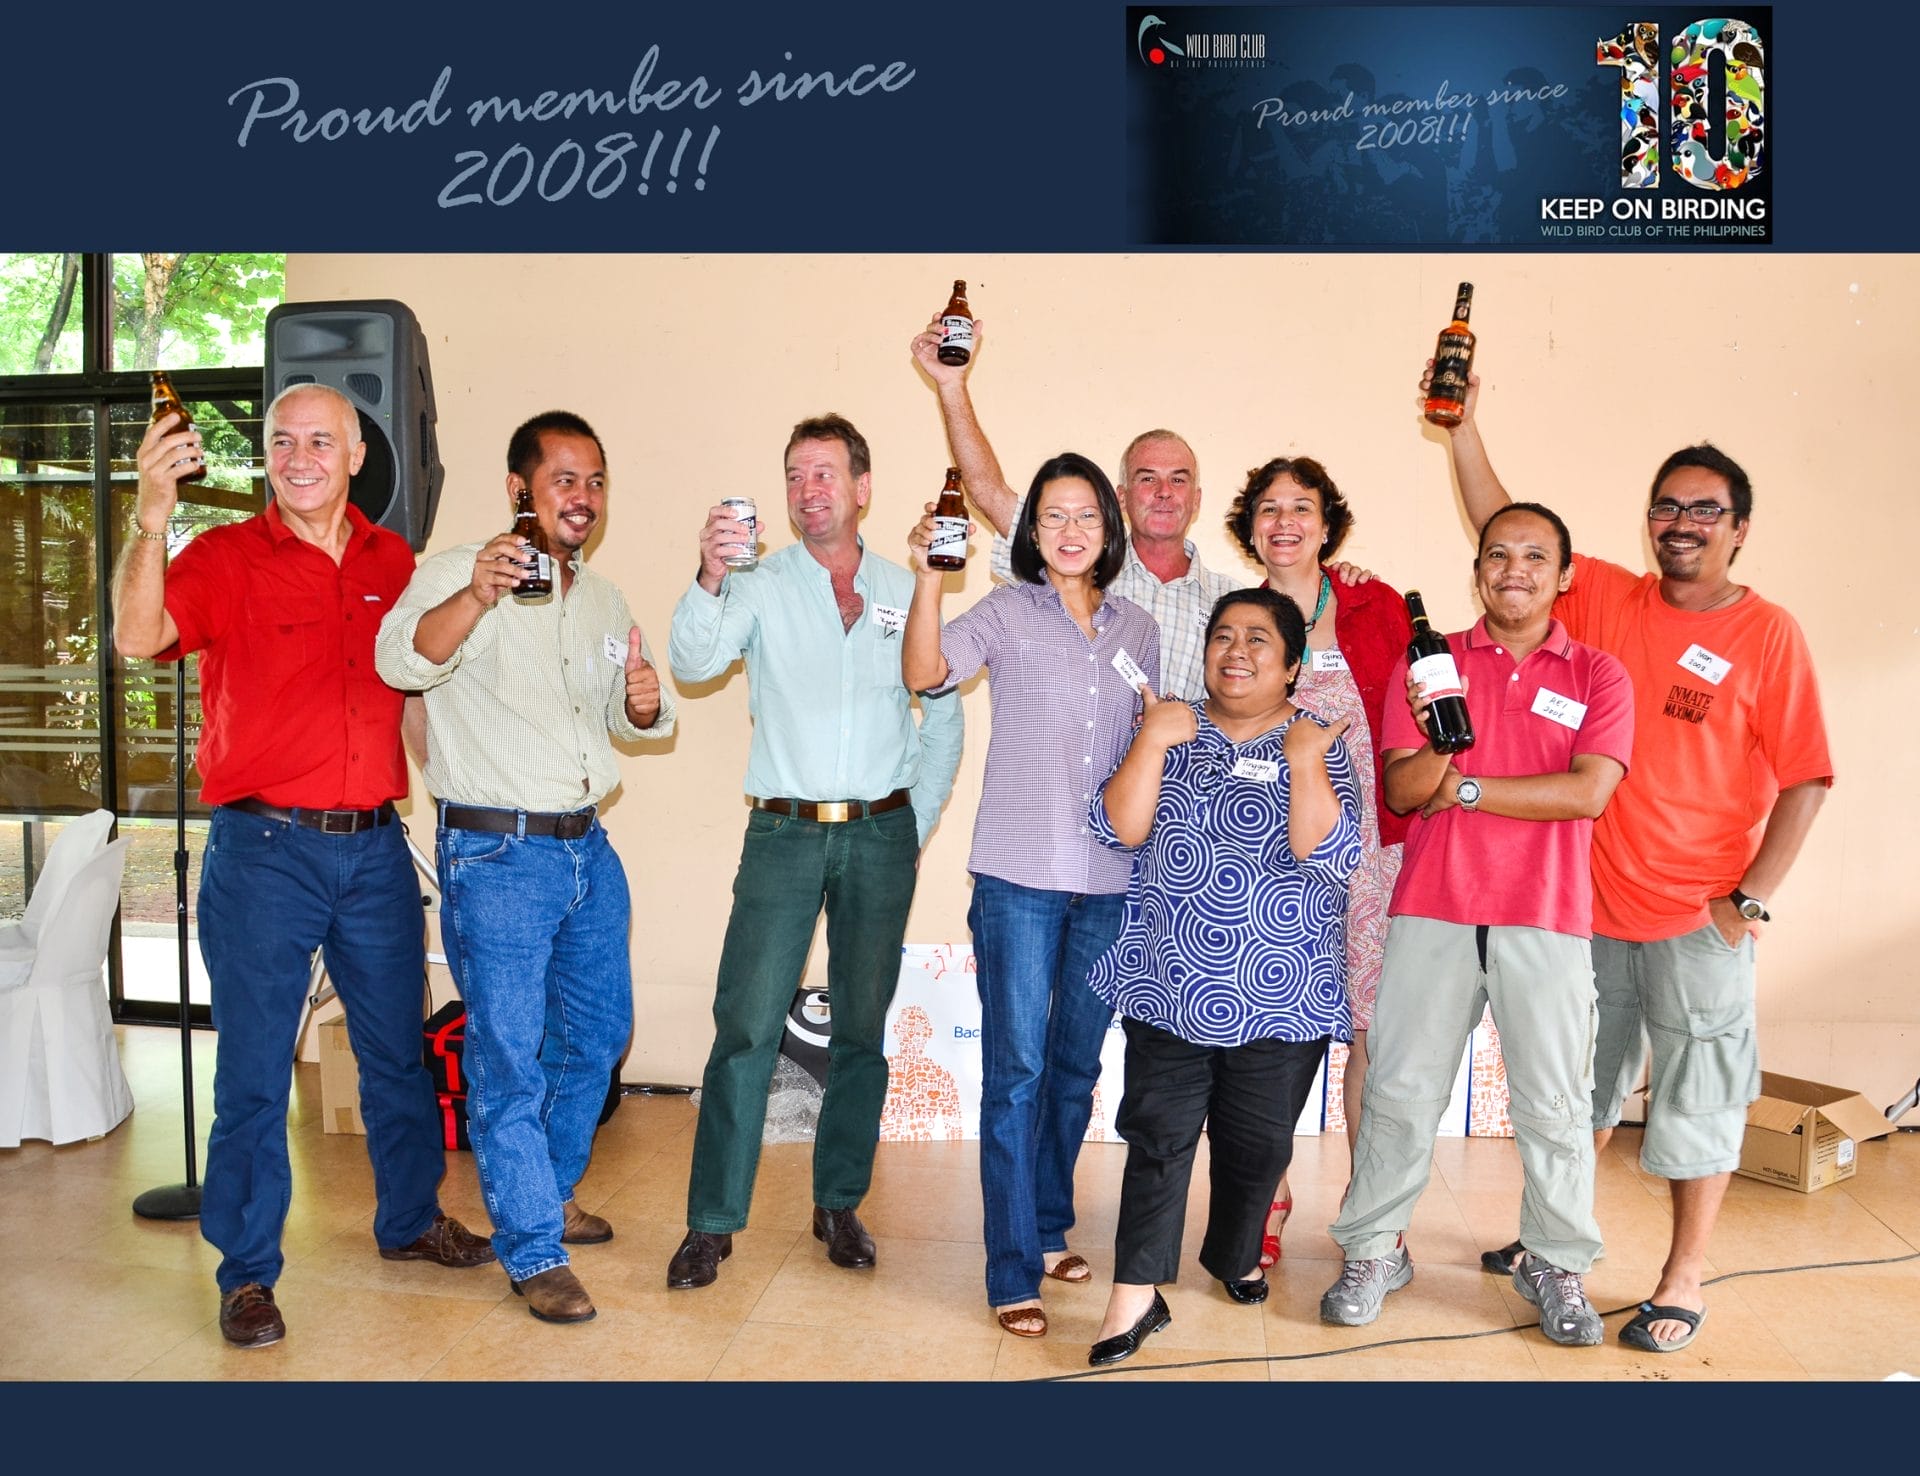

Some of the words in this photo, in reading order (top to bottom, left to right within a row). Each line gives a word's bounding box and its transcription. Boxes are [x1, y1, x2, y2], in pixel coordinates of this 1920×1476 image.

[1668, 685, 1714, 710] INMATE
[1662, 701, 1707, 725] MAXIMUM
[954, 1026, 980, 1038] Bac
